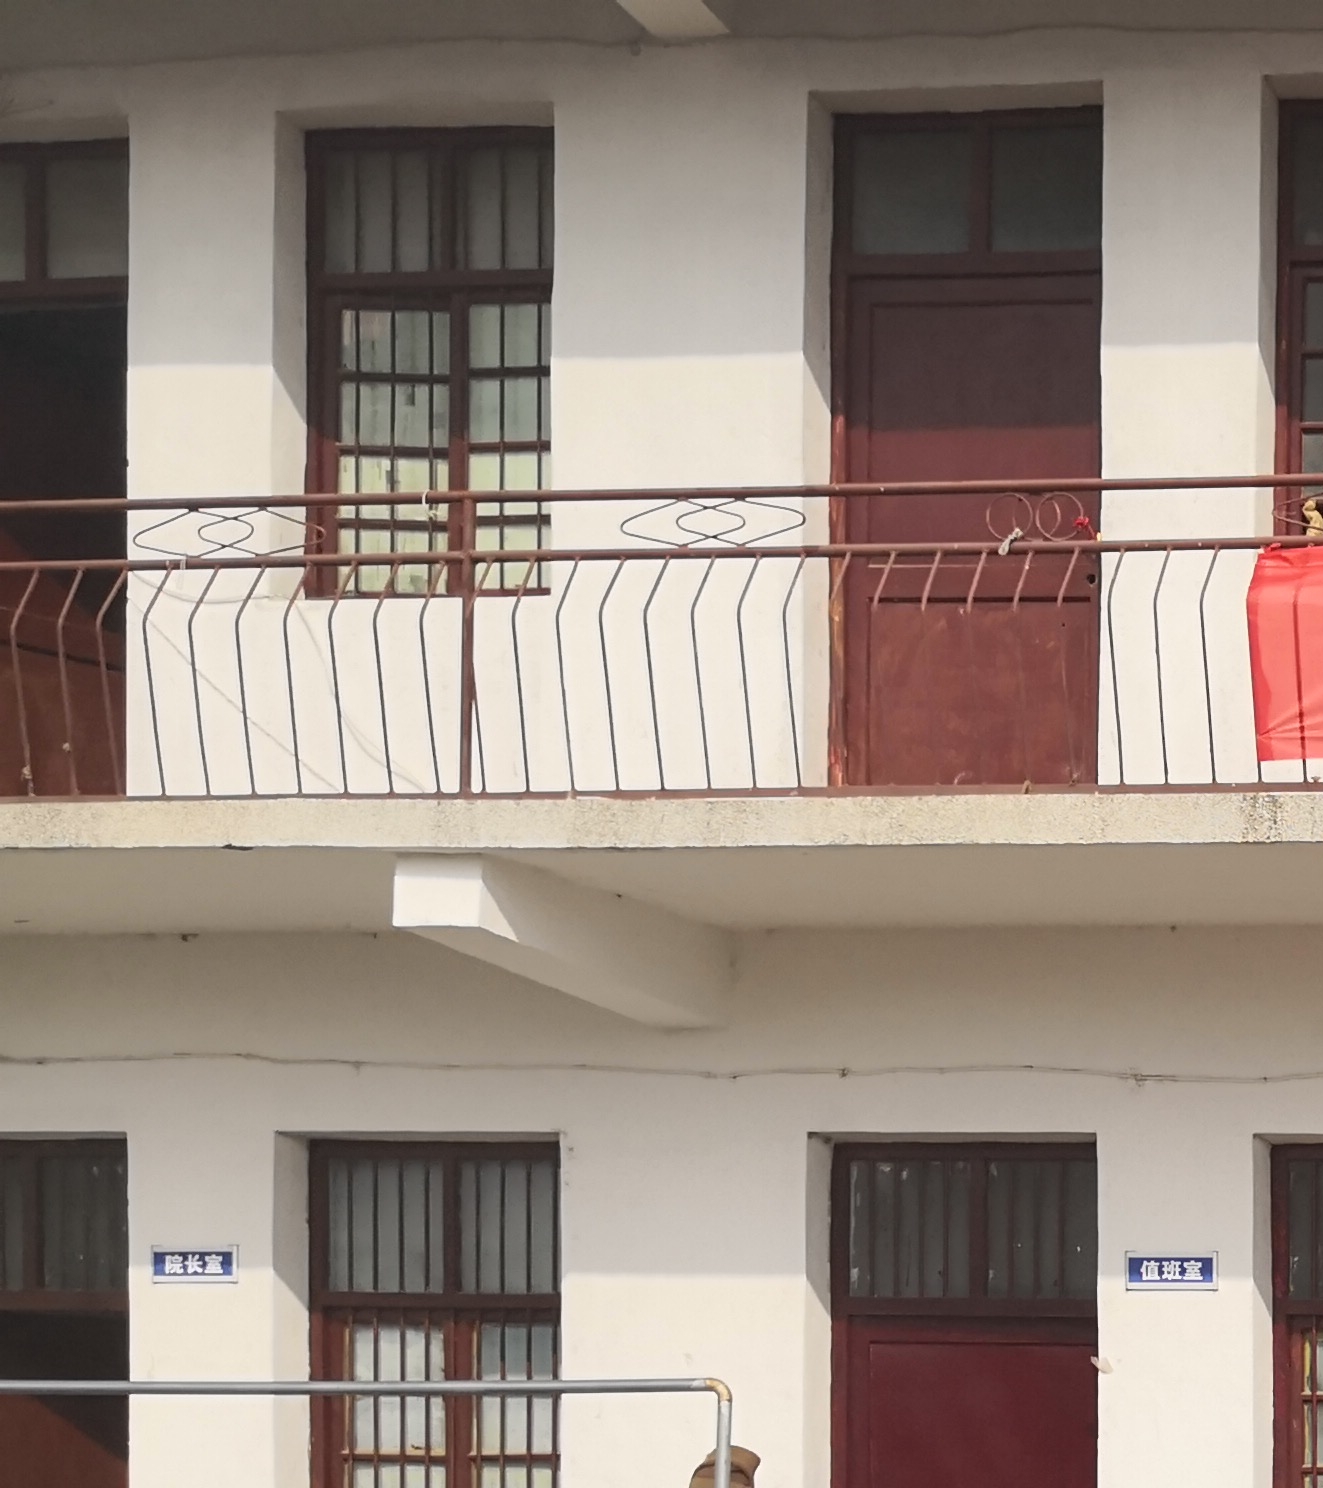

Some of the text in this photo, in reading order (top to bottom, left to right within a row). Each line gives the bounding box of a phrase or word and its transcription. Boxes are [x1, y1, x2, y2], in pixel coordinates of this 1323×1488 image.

[164, 1254, 224, 1275] 院长室
[1140, 1260, 1204, 1281] 值班室
